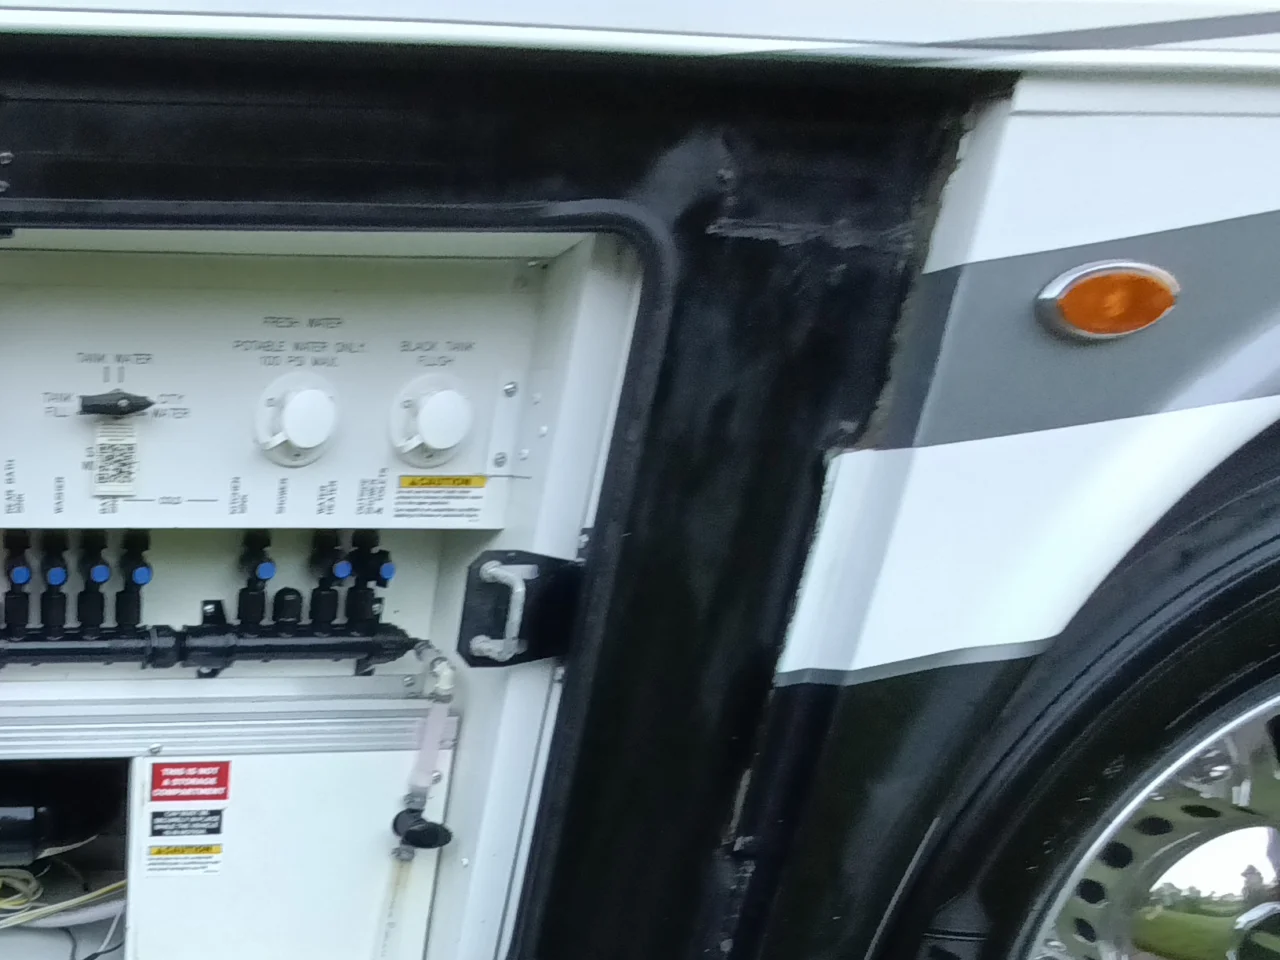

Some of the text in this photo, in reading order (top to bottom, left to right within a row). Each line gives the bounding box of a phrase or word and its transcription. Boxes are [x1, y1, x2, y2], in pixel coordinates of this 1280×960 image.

[306, 317, 343, 328] WATER
[232, 340, 287, 352] POTABLE
[292, 341, 329, 352] WATER
[400, 340, 476, 352] BLACK TANK
[115, 353, 155, 364] WATER
[161, 768, 185, 776] THIS
[198, 767, 220, 775] NOT
[172, 777, 218, 786] STORAGE
[152, 788, 226, 796] COMPARTMENT
